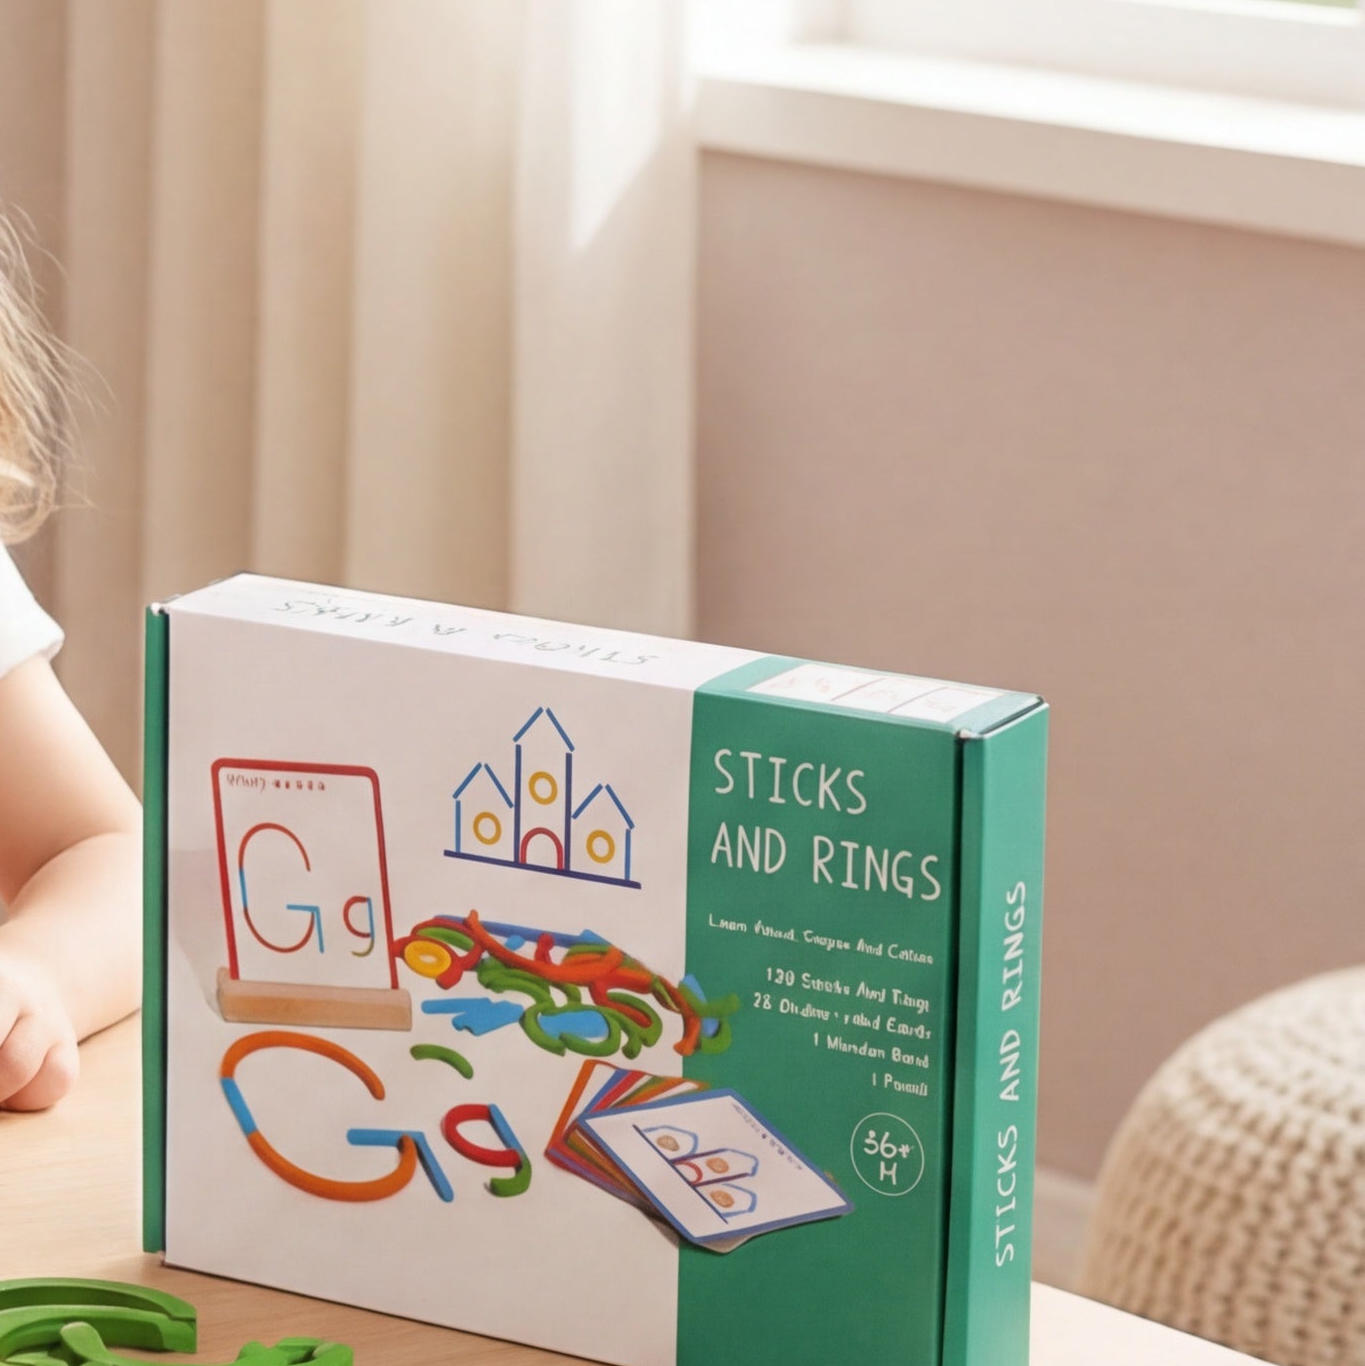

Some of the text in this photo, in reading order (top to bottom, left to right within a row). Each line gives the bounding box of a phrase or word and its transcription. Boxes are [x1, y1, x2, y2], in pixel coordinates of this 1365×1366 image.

[714, 748, 867, 815] STICKS
[711, 821, 941, 901] AND RINGS
[995, 881, 1027, 1267] STICKS AND RINGS
